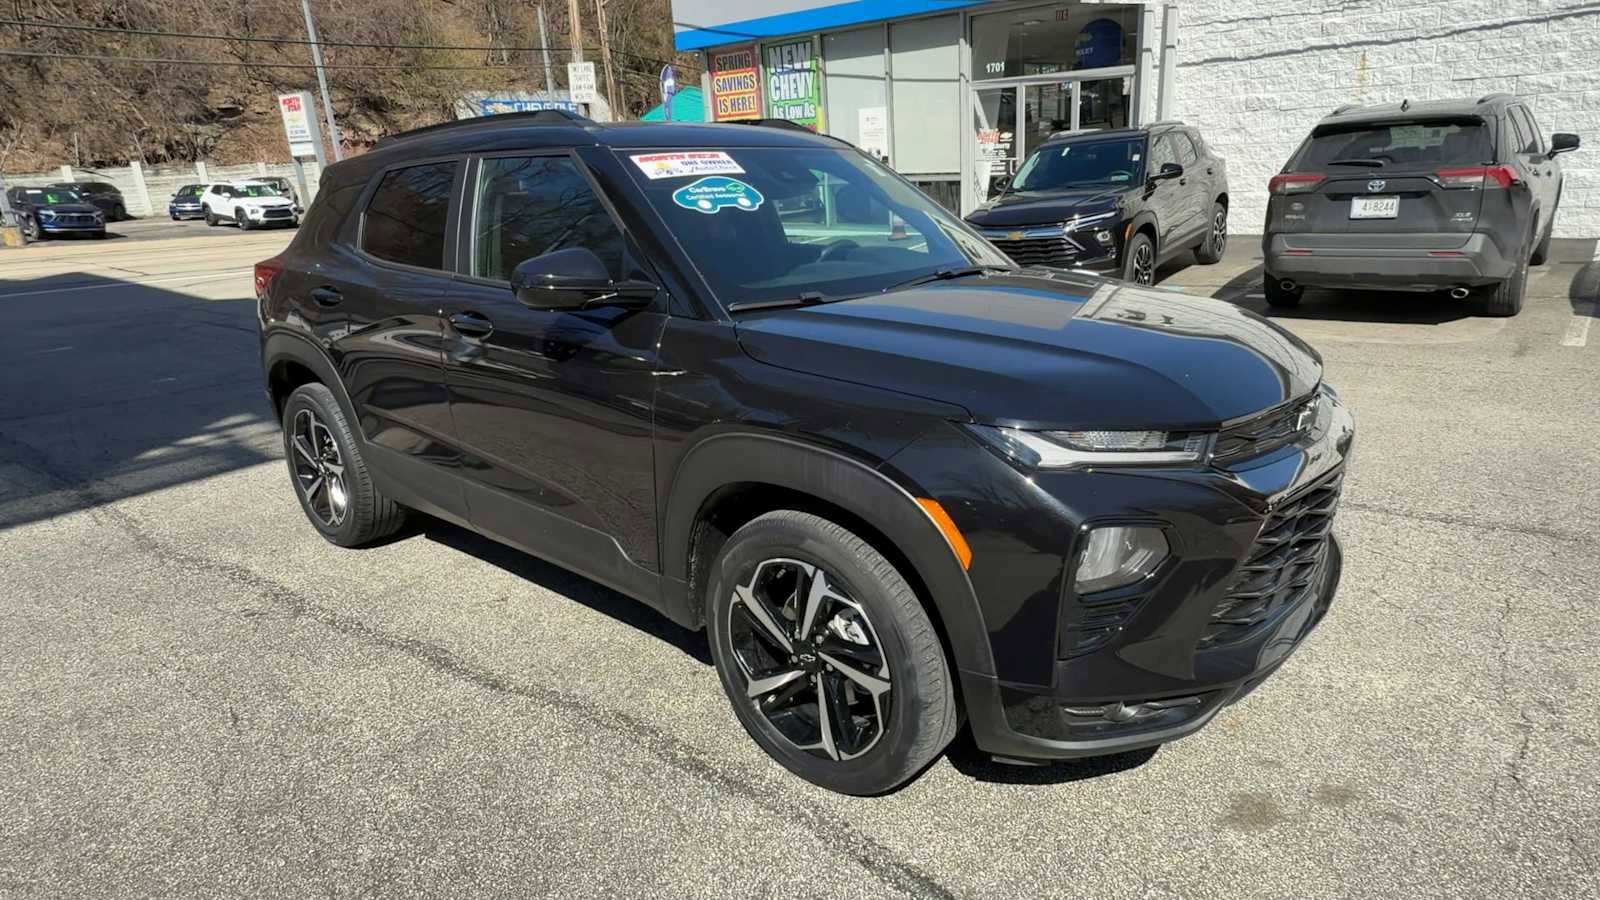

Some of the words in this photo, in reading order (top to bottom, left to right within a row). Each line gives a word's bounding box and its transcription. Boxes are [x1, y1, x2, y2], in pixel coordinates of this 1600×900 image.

[716, 52, 751, 70] SPRING
[768, 42, 812, 74] NEW
[986, 62, 1005, 73] 1701
[715, 74, 756, 93] SAVINGS
[770, 72, 814, 101] CHEVY
[719, 98, 728, 113] IS
[730, 96, 756, 112] HERE!
